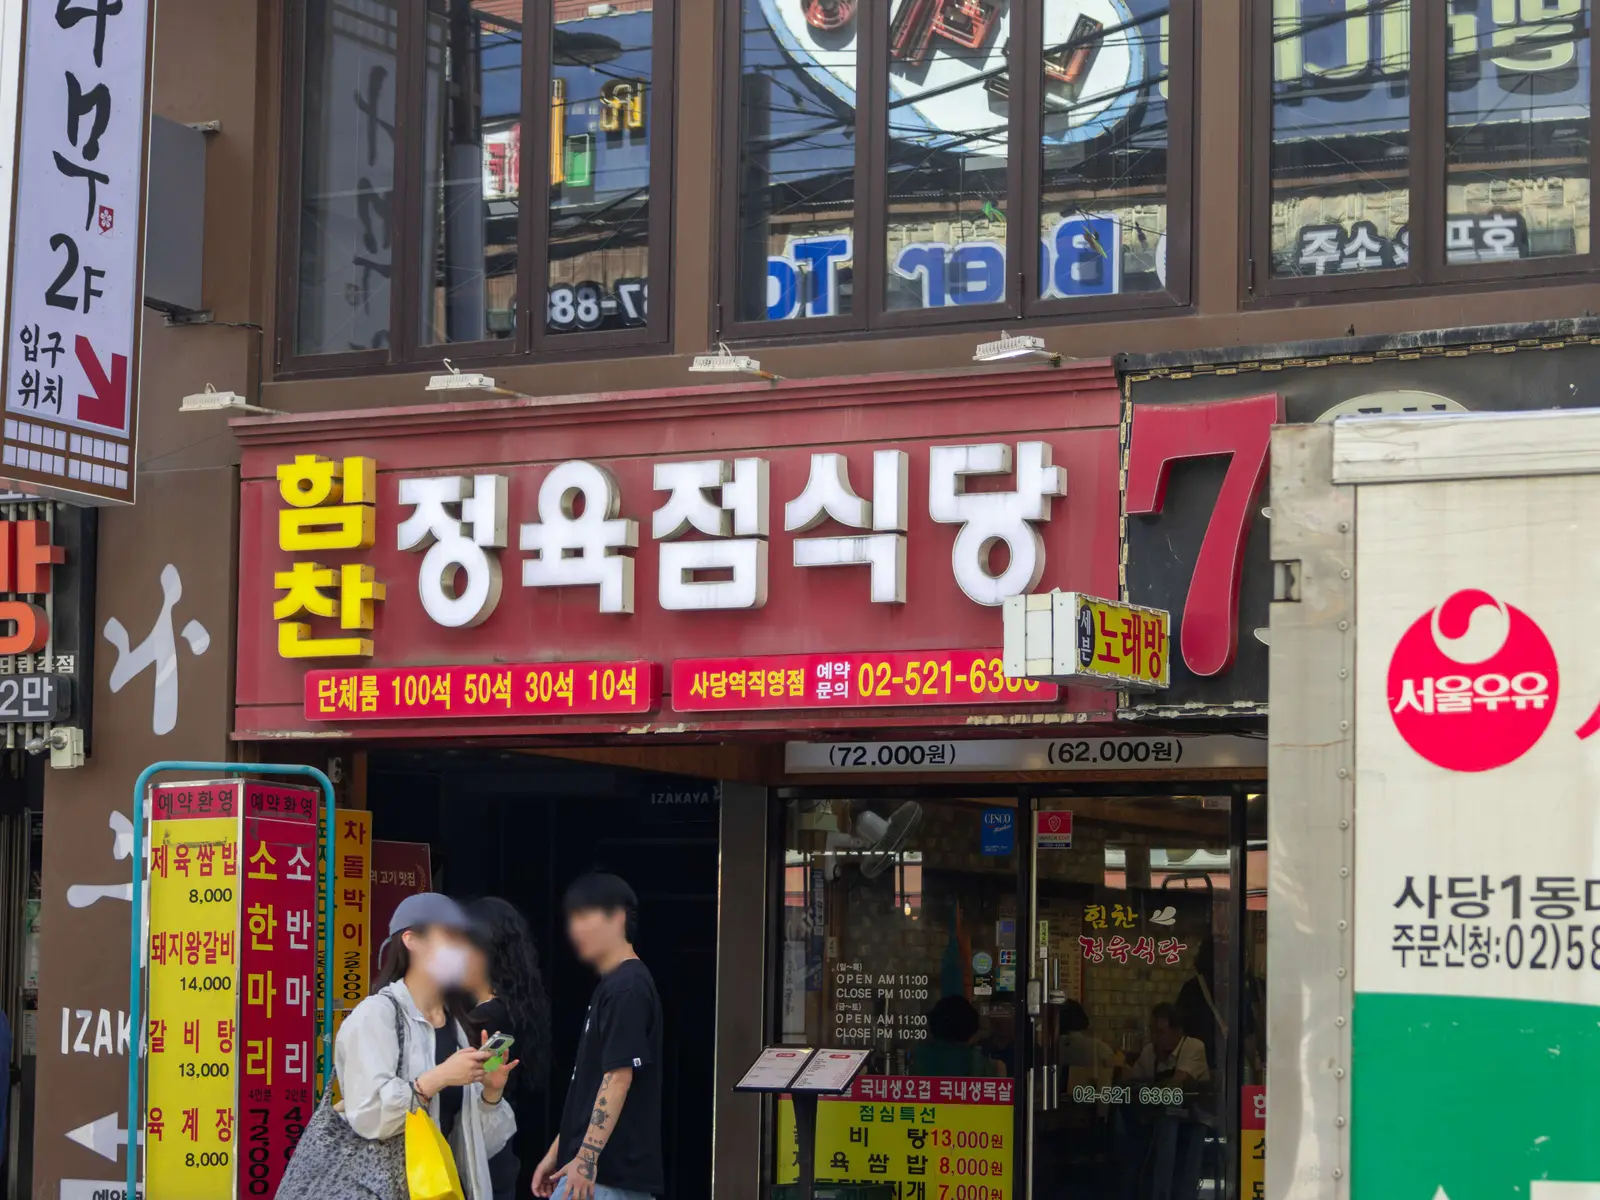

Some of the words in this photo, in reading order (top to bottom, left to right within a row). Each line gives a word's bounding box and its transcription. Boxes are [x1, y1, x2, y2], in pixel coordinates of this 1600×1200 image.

[45, 233, 106, 314] 2F
[19, 324, 65, 368] 입구
[17, 369, 63, 414] 위치
[397, 441, 1067, 628] 정육점식당
[1126, 393, 1284, 676] 7
[273, 454, 385, 659] 힘찬
[1097, 611, 1165, 679] 노래방
[689, 667, 805, 698] 사당역직영점
[816, 662, 851, 682] 예약
[318, 675, 379, 712] 단체룸
[392, 673, 451, 709] 100석
[464, 670, 512, 708] 50석
[525, 669, 574, 706] 30석
[588, 667, 637, 704] 10석
[816, 681, 849, 699] 문의
[1393, 672, 1549, 714] 서울우유
[828, 742, 956, 767] (72.000원)
[1047, 739, 1183, 765] (62.000원)
[158, 789, 233, 814] 예약환영
[651, 792, 709, 804] IZAKAYA
[984, 813, 1011, 824] CESCO
[151, 841, 238, 879] 제육쌈밥
[342, 820, 366, 946] 차돌박이
[189, 888, 232, 905] 8,000
[1084, 904, 1138, 930] 힘찬
[151, 929, 235, 967] 돼지왕갈비
[1079, 935, 1187, 964] 정육식당
[180, 976, 231, 992] 14,000
[836, 974, 872, 985] OPEN
[878, 974, 895, 985] AM
[899, 974, 928, 986] 11:00
[836, 988, 872, 999] CLOSE
[877, 988, 894, 999] PM
[899, 988, 928, 1000] 10:00
[836, 1013, 872, 1024] OPEN
[877, 1014, 894, 1025] AM
[898, 1014, 927, 1026] 11:00
[61, 1007, 147, 1059] IZAK
[150, 1019, 236, 1054] 갈비탕
[835, 1027, 871, 1038] CLOSE
[877, 1028, 893, 1039] PM
[898, 1029, 927, 1040] 10:30
[178, 1063, 229, 1078] 13,000
[860, 1078, 931, 1100] 국내생오겹
[939, 1081, 1012, 1103] 국내생목살
[1073, 1086, 1131, 1104] 02-521
[1139, 1086, 1183, 1105] 6366
[147, 1107, 234, 1143] 육계장
[859, 1105, 936, 1124] 점심특선
[931, 1128, 1003, 1150] 13,000원
[185, 1152, 228, 1168] 8,000
[939, 1156, 1003, 1177] 8,000원
